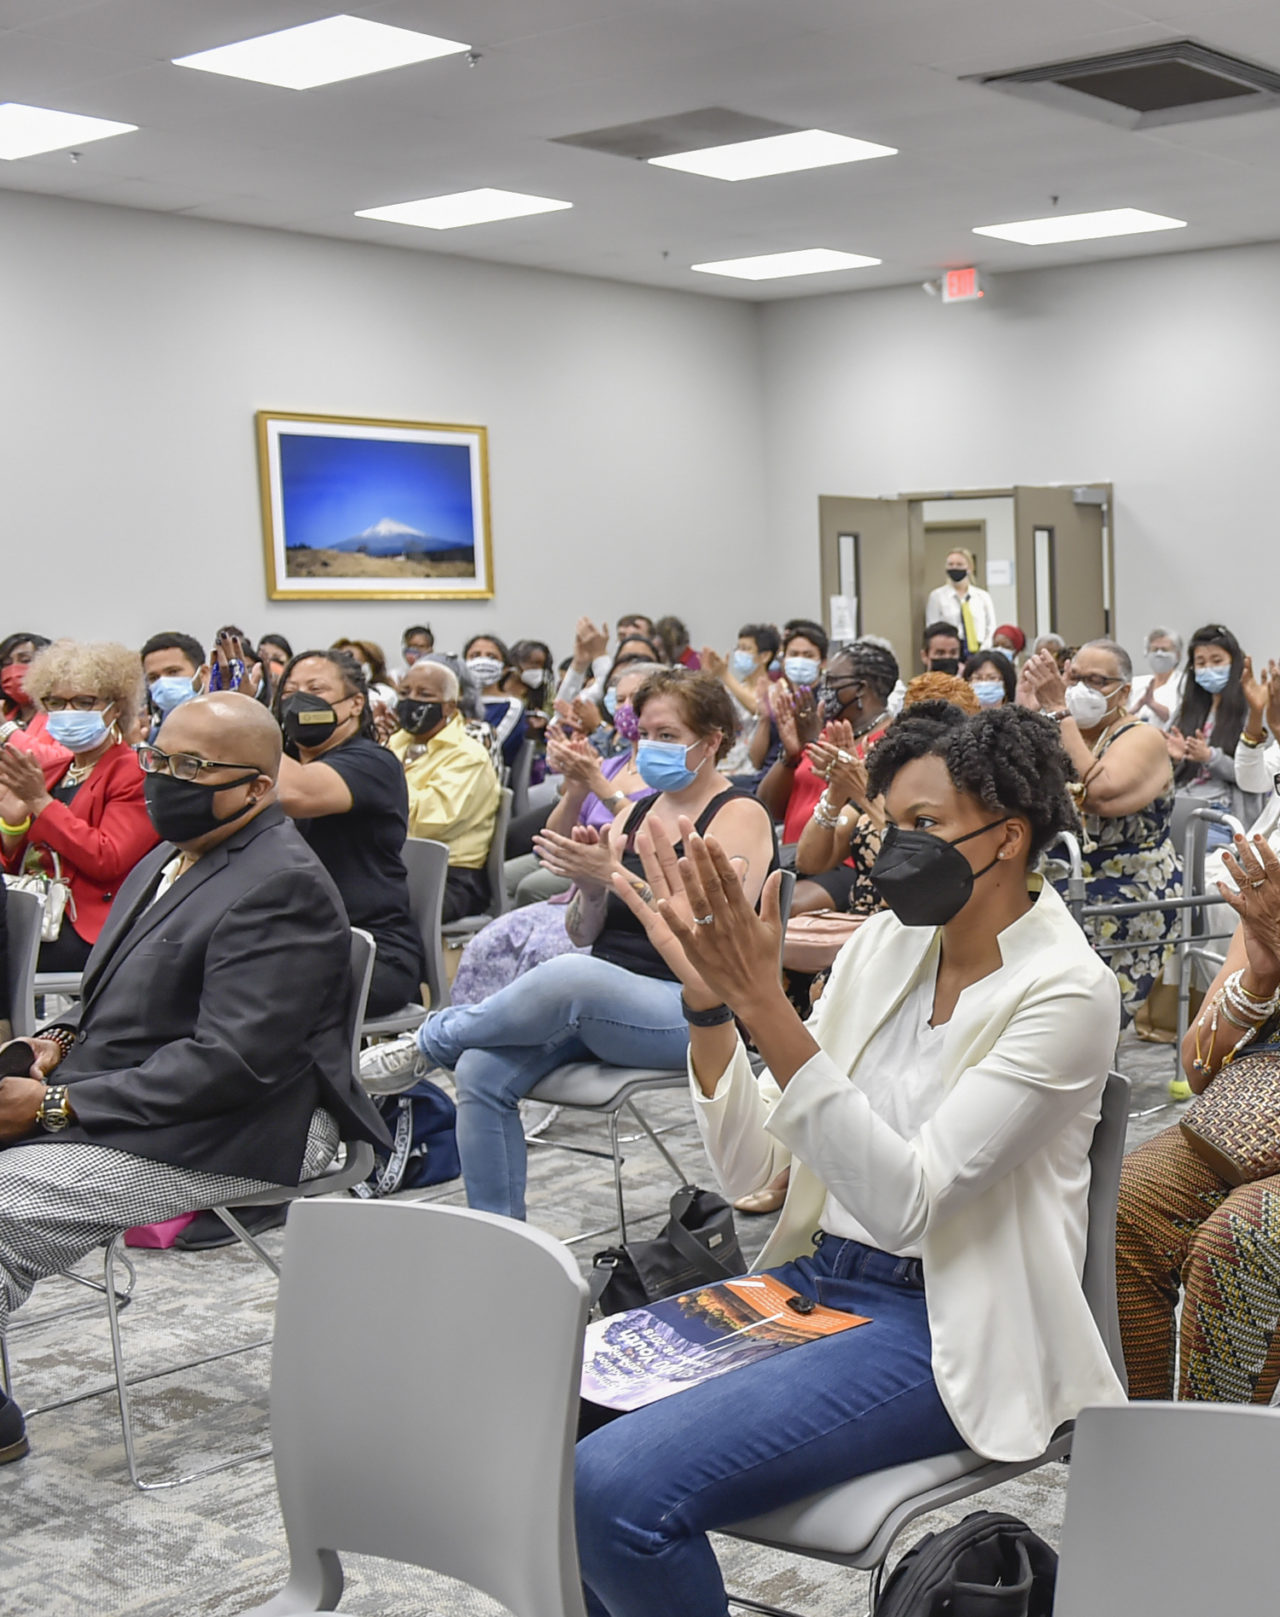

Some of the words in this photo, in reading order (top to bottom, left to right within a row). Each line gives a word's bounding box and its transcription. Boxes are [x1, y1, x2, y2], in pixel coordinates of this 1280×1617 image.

[946, 267, 977, 298] EXIT
[617, 1328, 659, 1363] Youth
[642, 1328, 666, 1346] 2018
